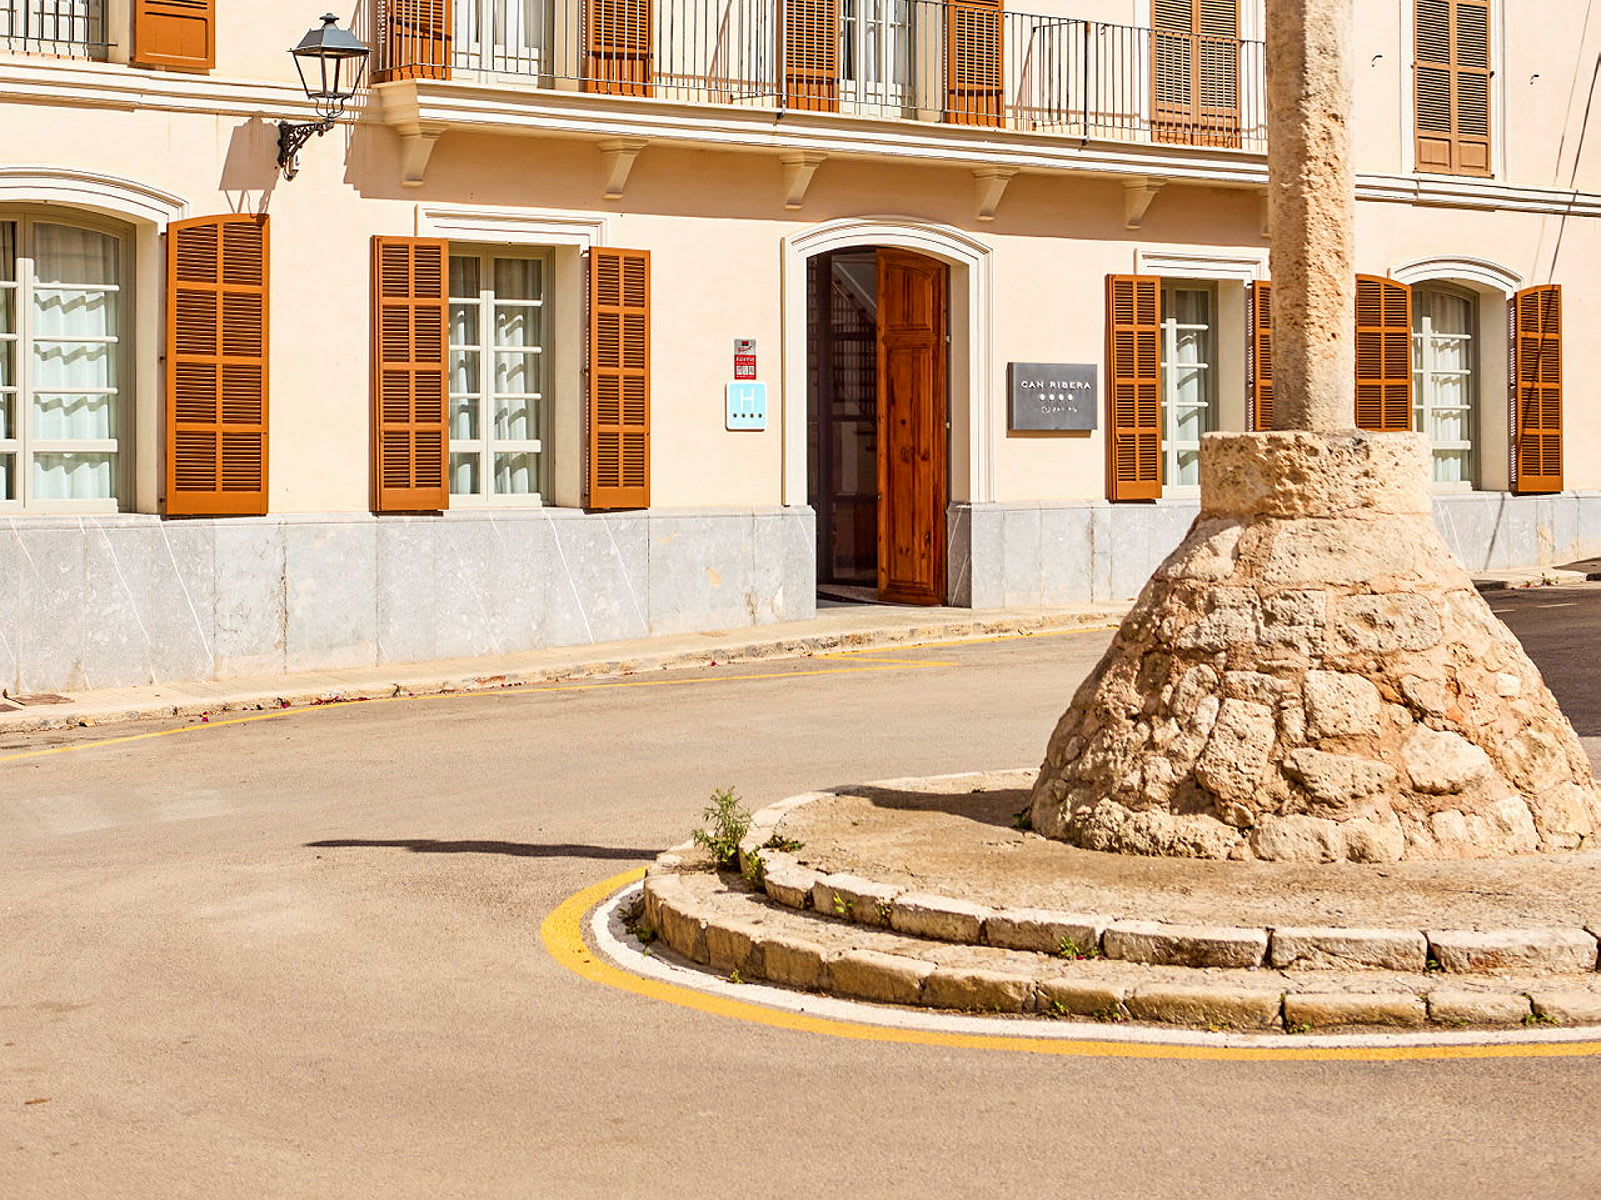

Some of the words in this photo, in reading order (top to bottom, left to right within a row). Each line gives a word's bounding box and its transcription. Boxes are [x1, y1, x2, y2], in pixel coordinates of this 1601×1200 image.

[1021, 380, 1044, 389] CAN
[1050, 381, 1092, 390] RIBERA
[739, 388, 755, 411] H
